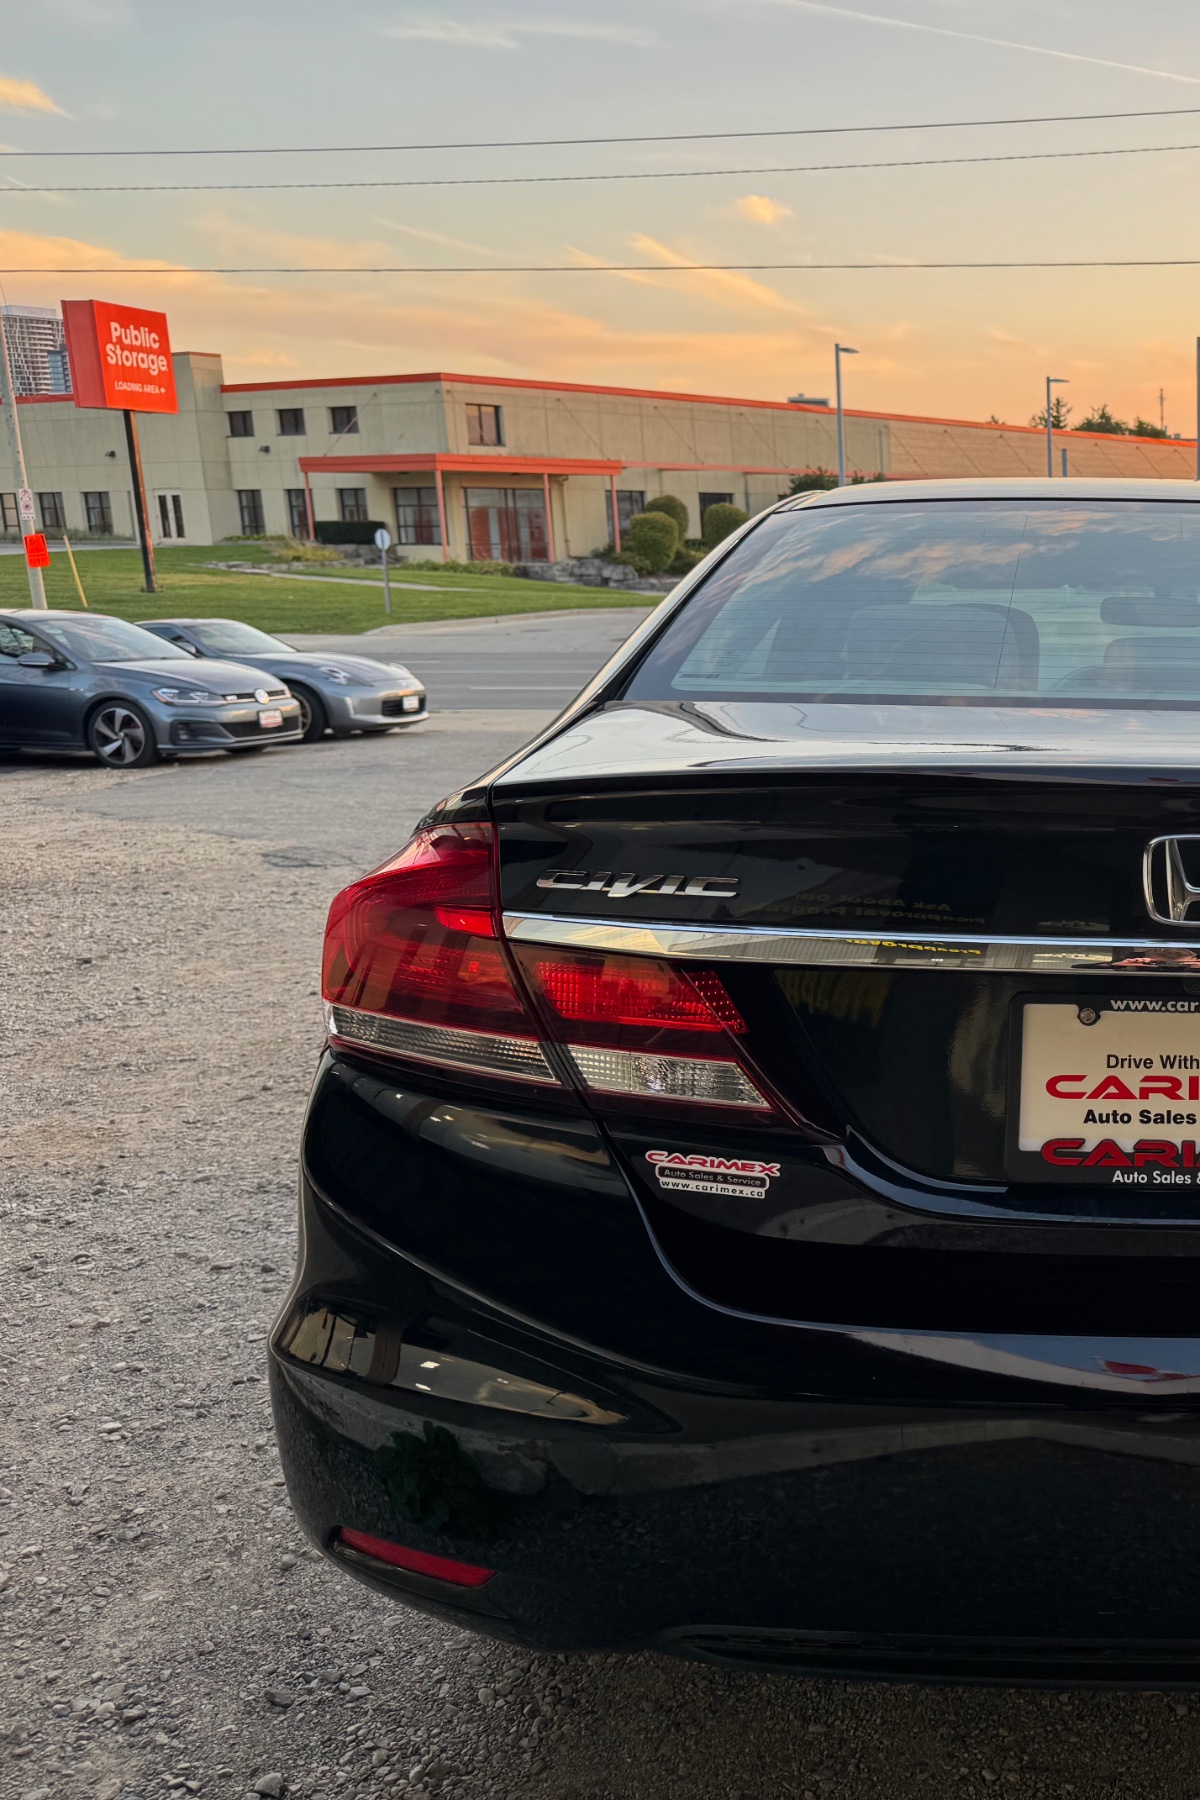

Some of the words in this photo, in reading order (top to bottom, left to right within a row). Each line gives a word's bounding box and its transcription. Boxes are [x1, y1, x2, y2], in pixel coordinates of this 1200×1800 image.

[110, 321, 159, 349] Public
[105, 343, 168, 376] Storage
[114, 381, 142, 392] LOADING
[143, 384, 160, 394] AREA
[536, 869, 739, 897] CIVIC
[1106, 1054, 1154, 1070] Drive
[1159, 1055, 1200, 1070] With
[1083, 1109, 1132, 1125] Auto
[1139, 1110, 1197, 1125] Sales
[647, 1152, 780, 1175] CARIMEX
[664, 1169, 686, 1178] Auto
[688, 1171, 714, 1182] Sales
[727, 1176, 762, 1186] Service
[1112, 1170, 1148, 1184] Auto
[1152, 1171, 1192, 1185] Sales
[661, 1179, 764, 1198] www.carimex.ca
